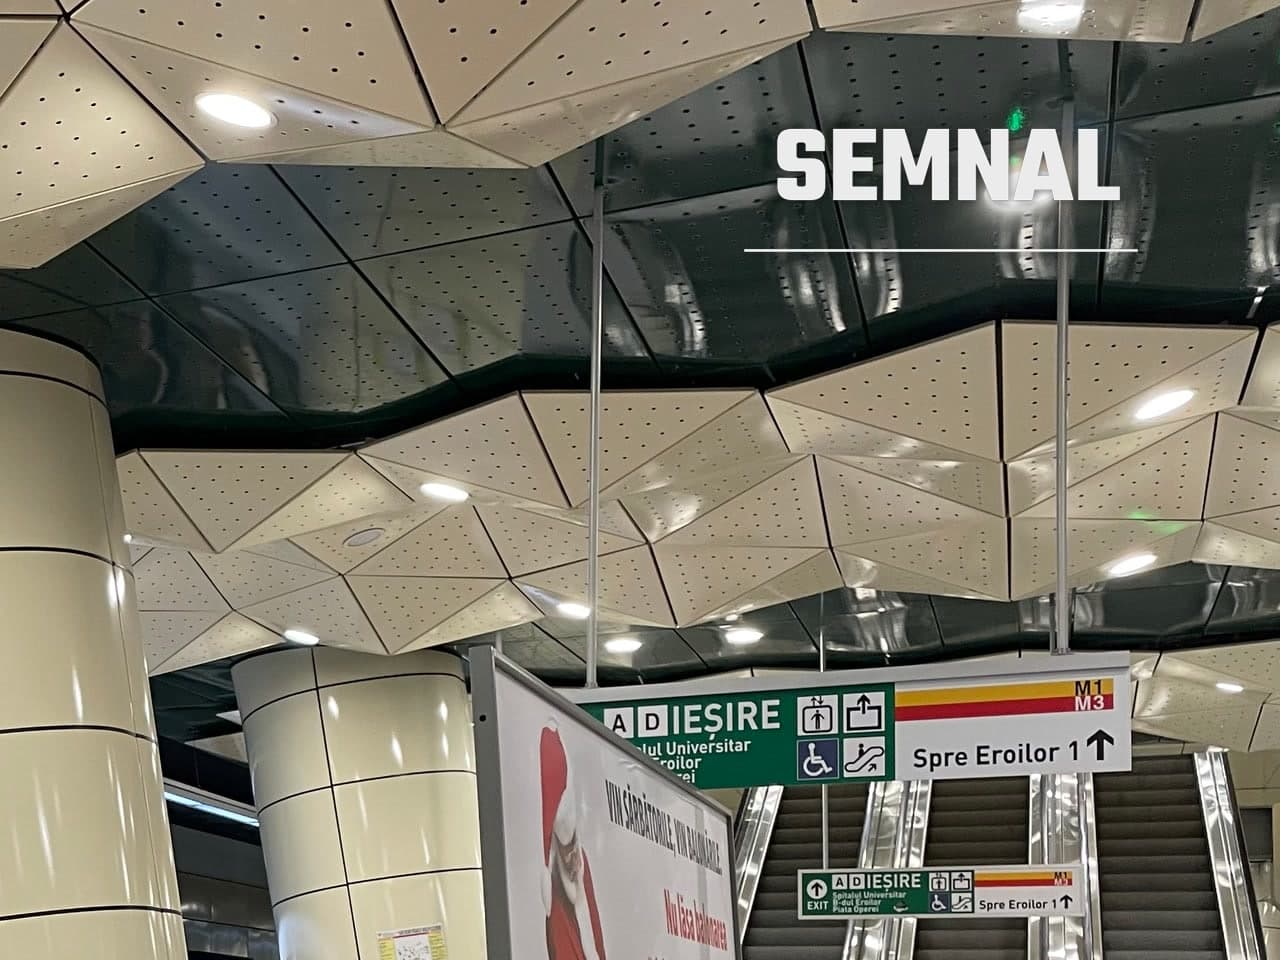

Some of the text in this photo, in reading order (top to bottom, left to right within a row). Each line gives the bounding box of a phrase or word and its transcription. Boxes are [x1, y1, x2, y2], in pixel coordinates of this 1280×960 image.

[1075, 679, 1102, 697] M1
[1075, 695, 1105, 711] M3
[612, 700, 781, 741] A D IEȘIRE
[666, 739, 752, 756] Universitar
[913, 740, 1078, 772] Spre Eroilor 1
[863, 891, 907, 899] Universitar
[664, 888, 679, 937] Nu
[807, 901, 829, 911] EXIT
[979, 900, 1005, 911] Spre
[1009, 899, 1048, 909] Eroilor
